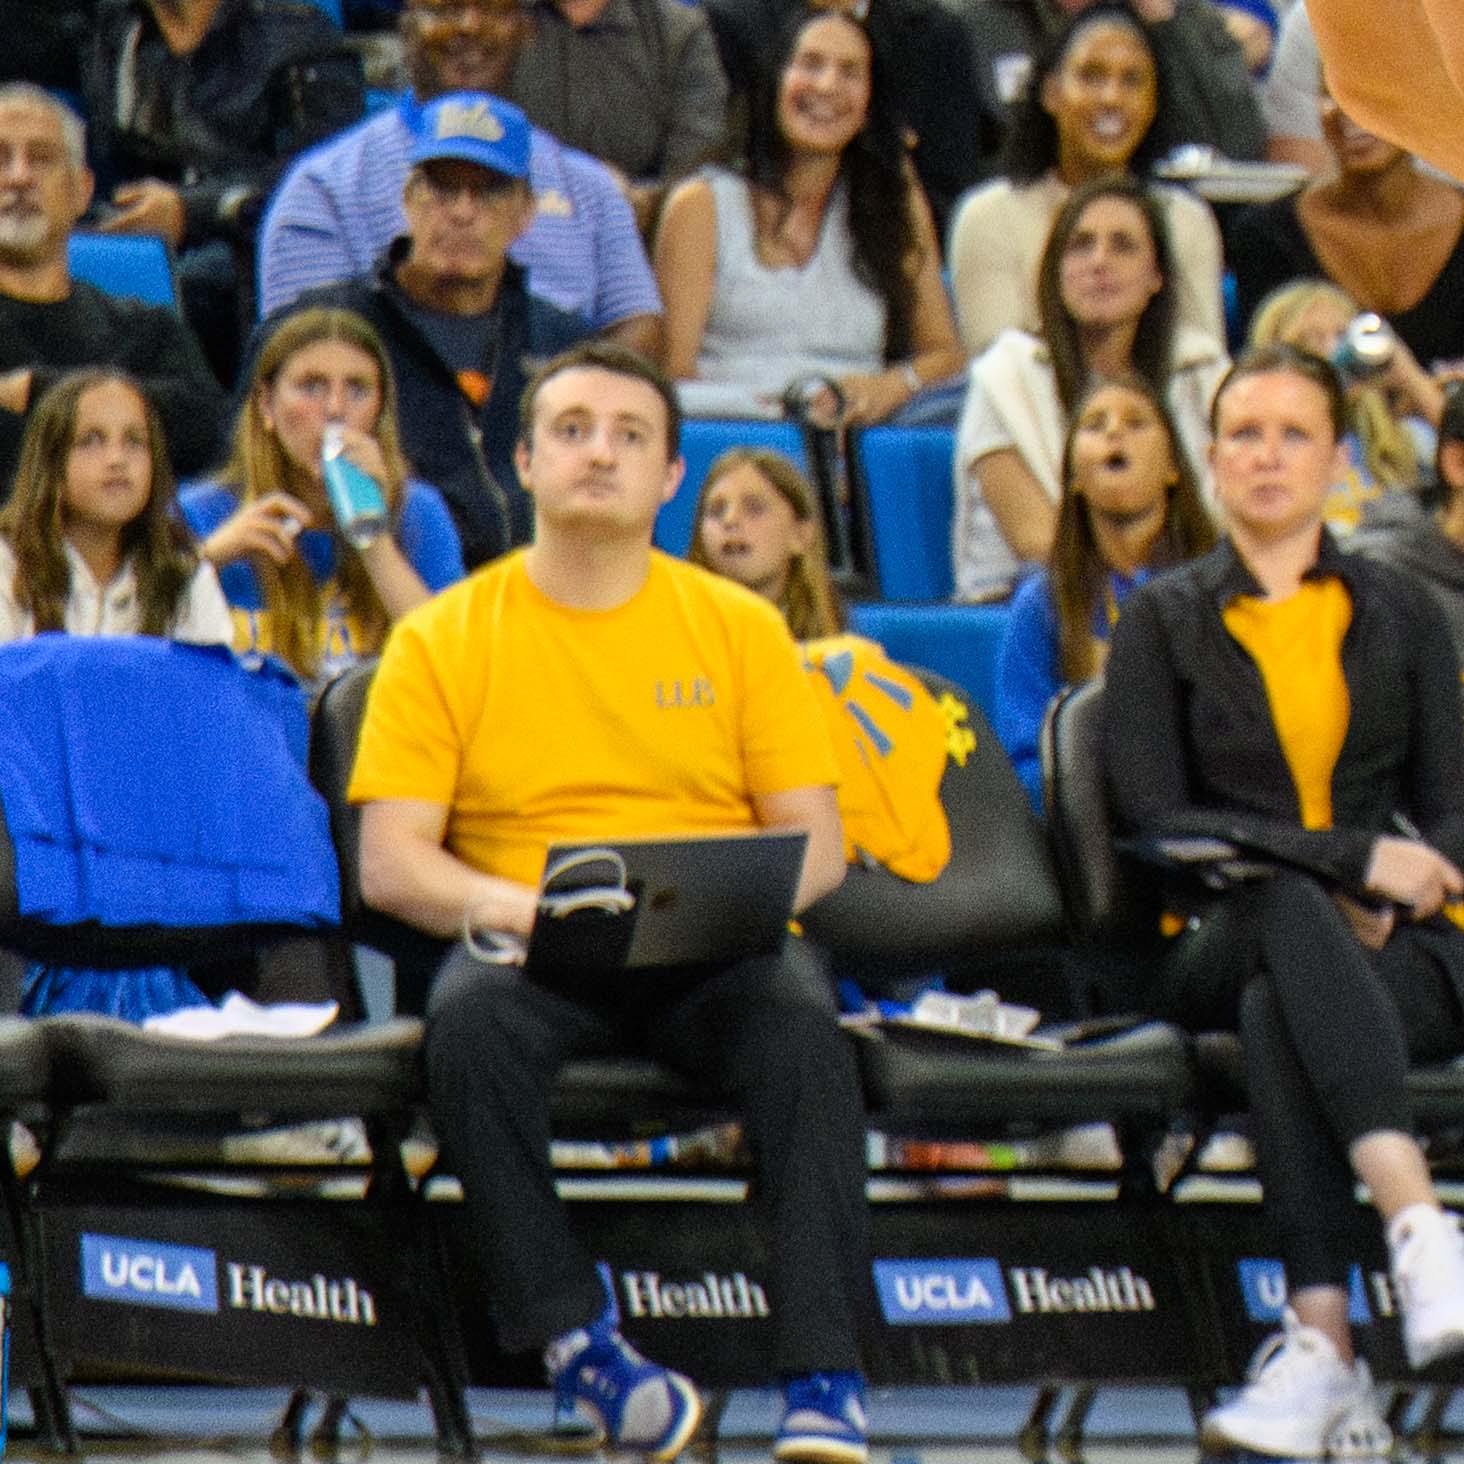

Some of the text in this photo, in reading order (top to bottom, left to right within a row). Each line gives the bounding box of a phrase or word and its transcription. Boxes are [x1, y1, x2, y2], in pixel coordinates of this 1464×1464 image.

[101, 1251, 377, 1326] UCLA Health
[622, 1271, 771, 1318] Health
[893, 1266, 1156, 1314] UCLA Health
